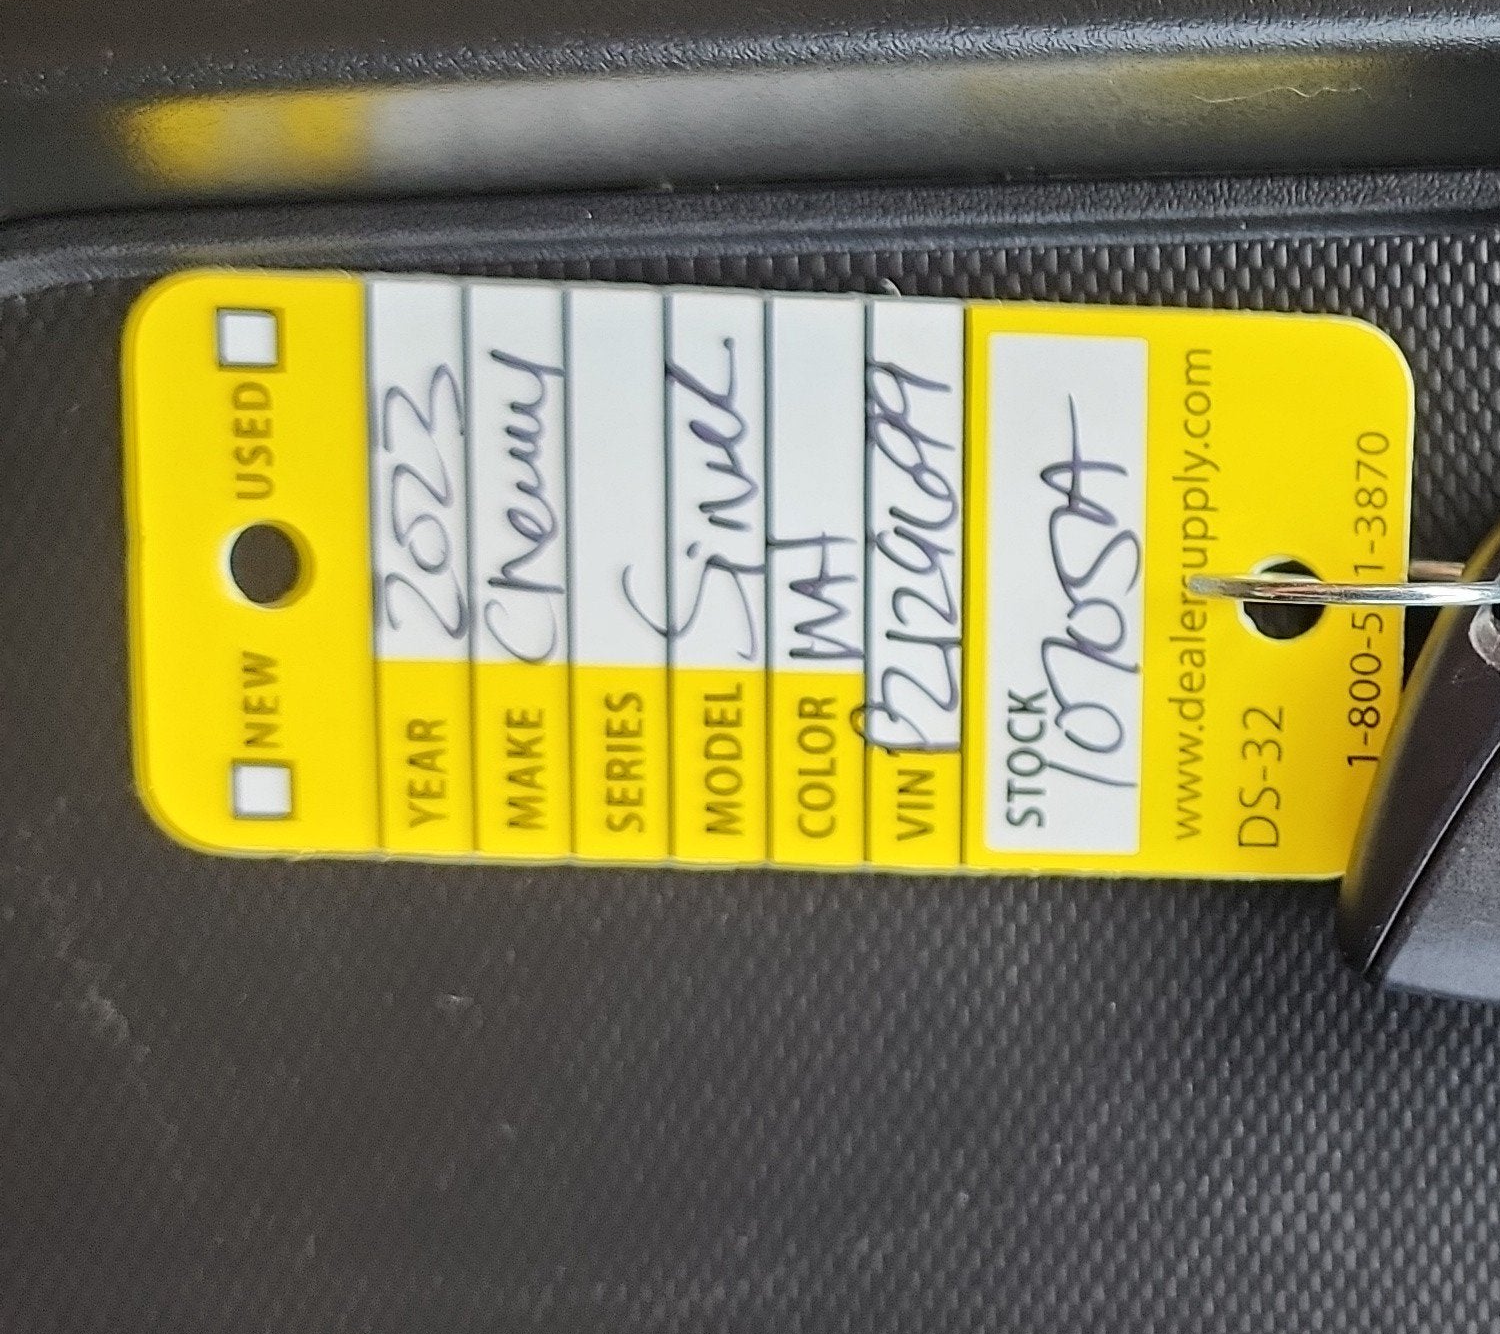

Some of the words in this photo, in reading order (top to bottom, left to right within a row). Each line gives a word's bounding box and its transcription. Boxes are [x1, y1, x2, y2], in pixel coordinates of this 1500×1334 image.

[232, 381, 274, 501] USED
[383, 363, 469, 640] 2023
[1348, 431, 1391, 766] 1-800-51-3870
[243, 650, 280, 749] NEW
[506, 706, 547, 829] MAKE
[606, 691, 644, 833] SERIES
[706, 683, 744, 836] MODEL
[799, 693, 837, 839] COLOR
[1007, 688, 1047, 827] STOCK
[408, 717, 449, 828] YEAR
[897, 767, 935, 841] VIN
[1239, 704, 1284, 849] DS-32
